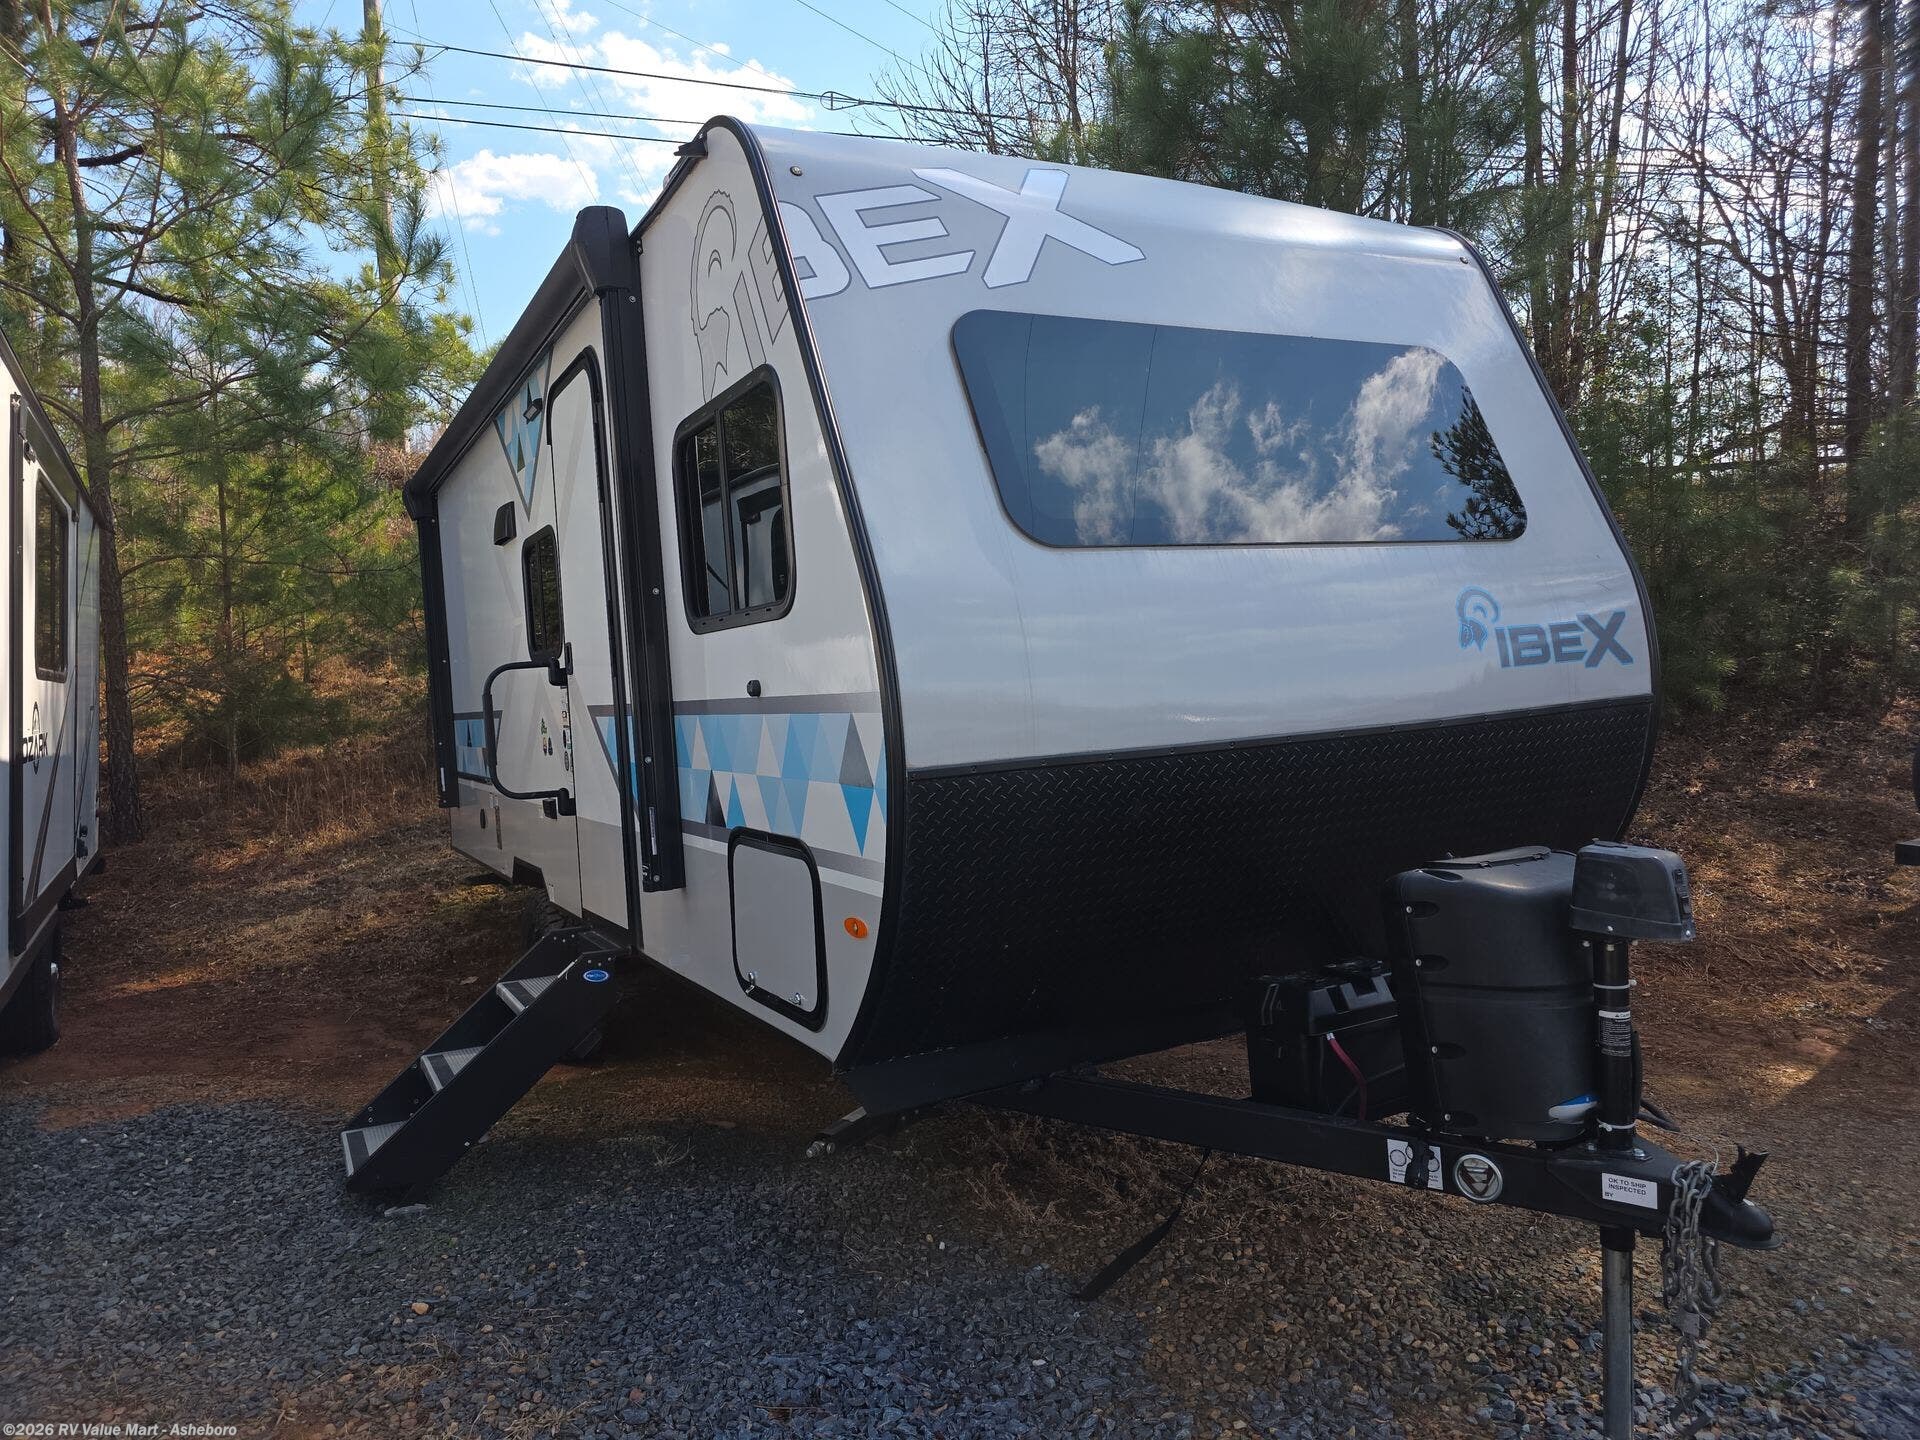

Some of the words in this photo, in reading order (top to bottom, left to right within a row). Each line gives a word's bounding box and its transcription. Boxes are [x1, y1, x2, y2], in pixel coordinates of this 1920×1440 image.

[732, 167, 1147, 371] IBEX
[1494, 609, 1634, 669] IBEX
[1608, 1183, 1647, 1196] INSPECTED
[1630, 1181, 1647, 1189] SHIP
